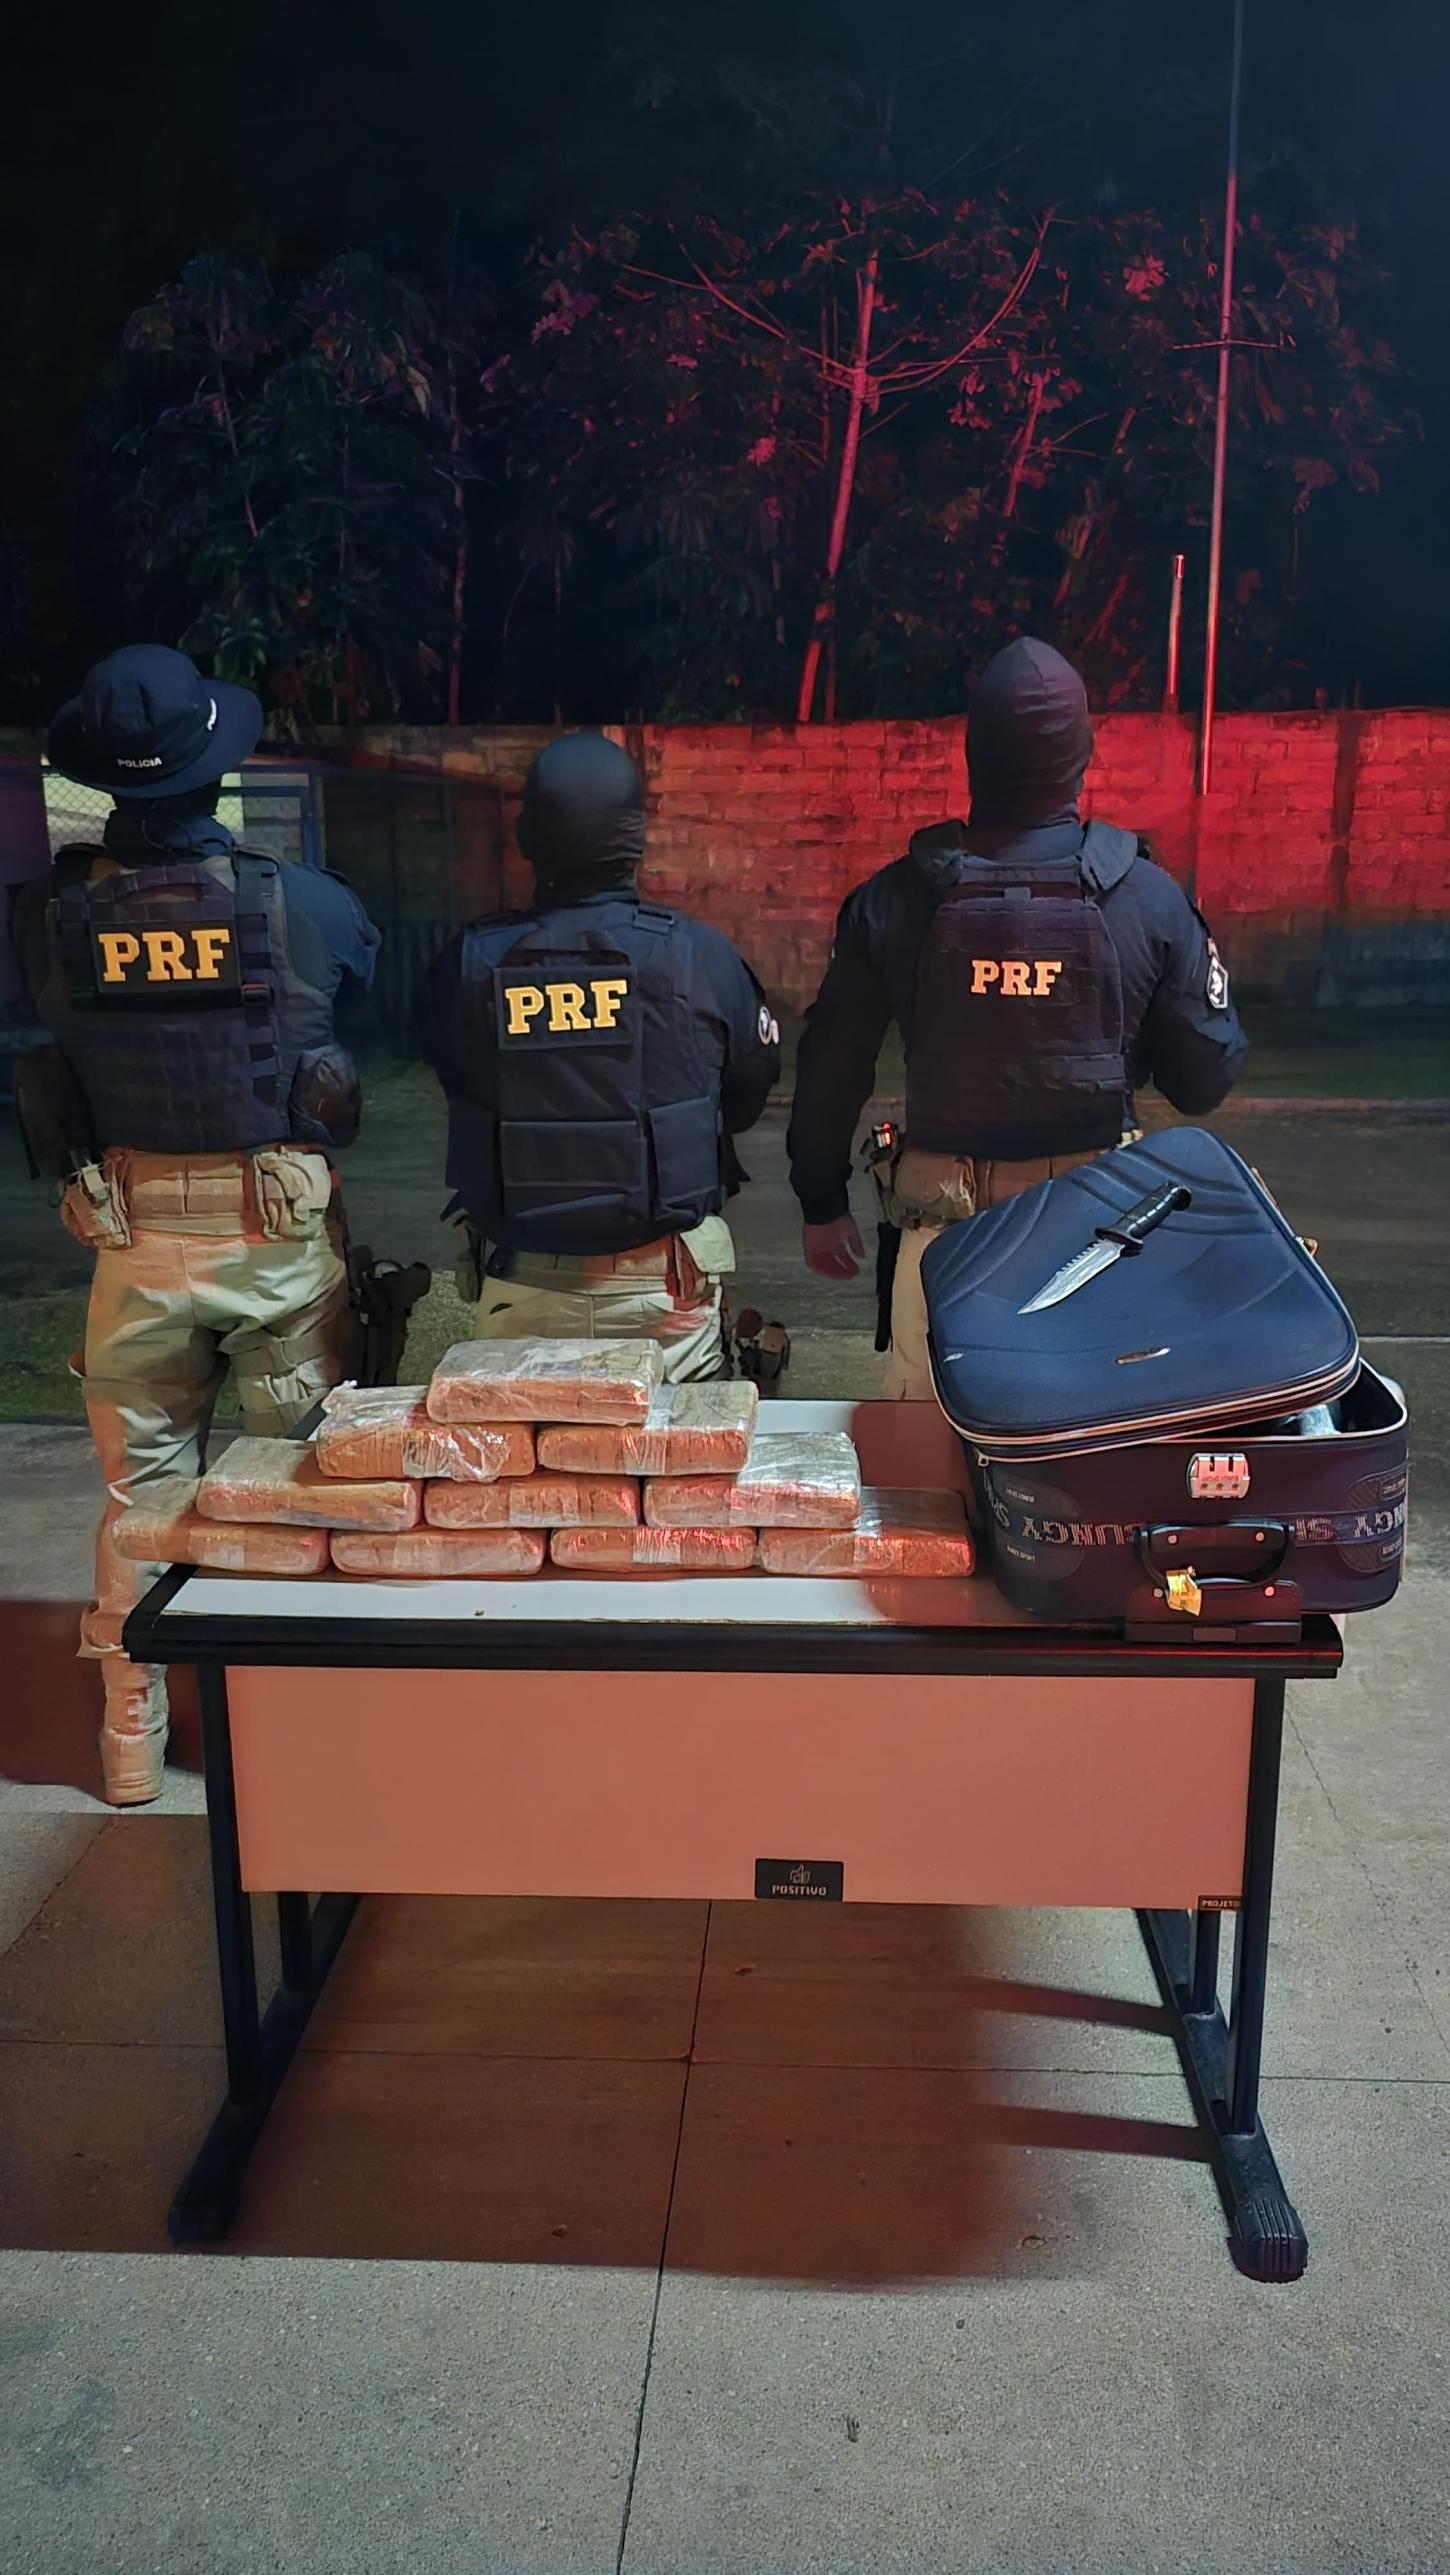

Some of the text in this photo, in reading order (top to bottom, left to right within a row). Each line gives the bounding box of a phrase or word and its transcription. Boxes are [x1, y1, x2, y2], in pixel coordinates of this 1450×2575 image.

[98, 928, 230, 982] PRF
[971, 960, 1062, 996] PRF
[505, 980, 627, 1034] PRF
[772, 1884, 827, 1896] POSITIVO
